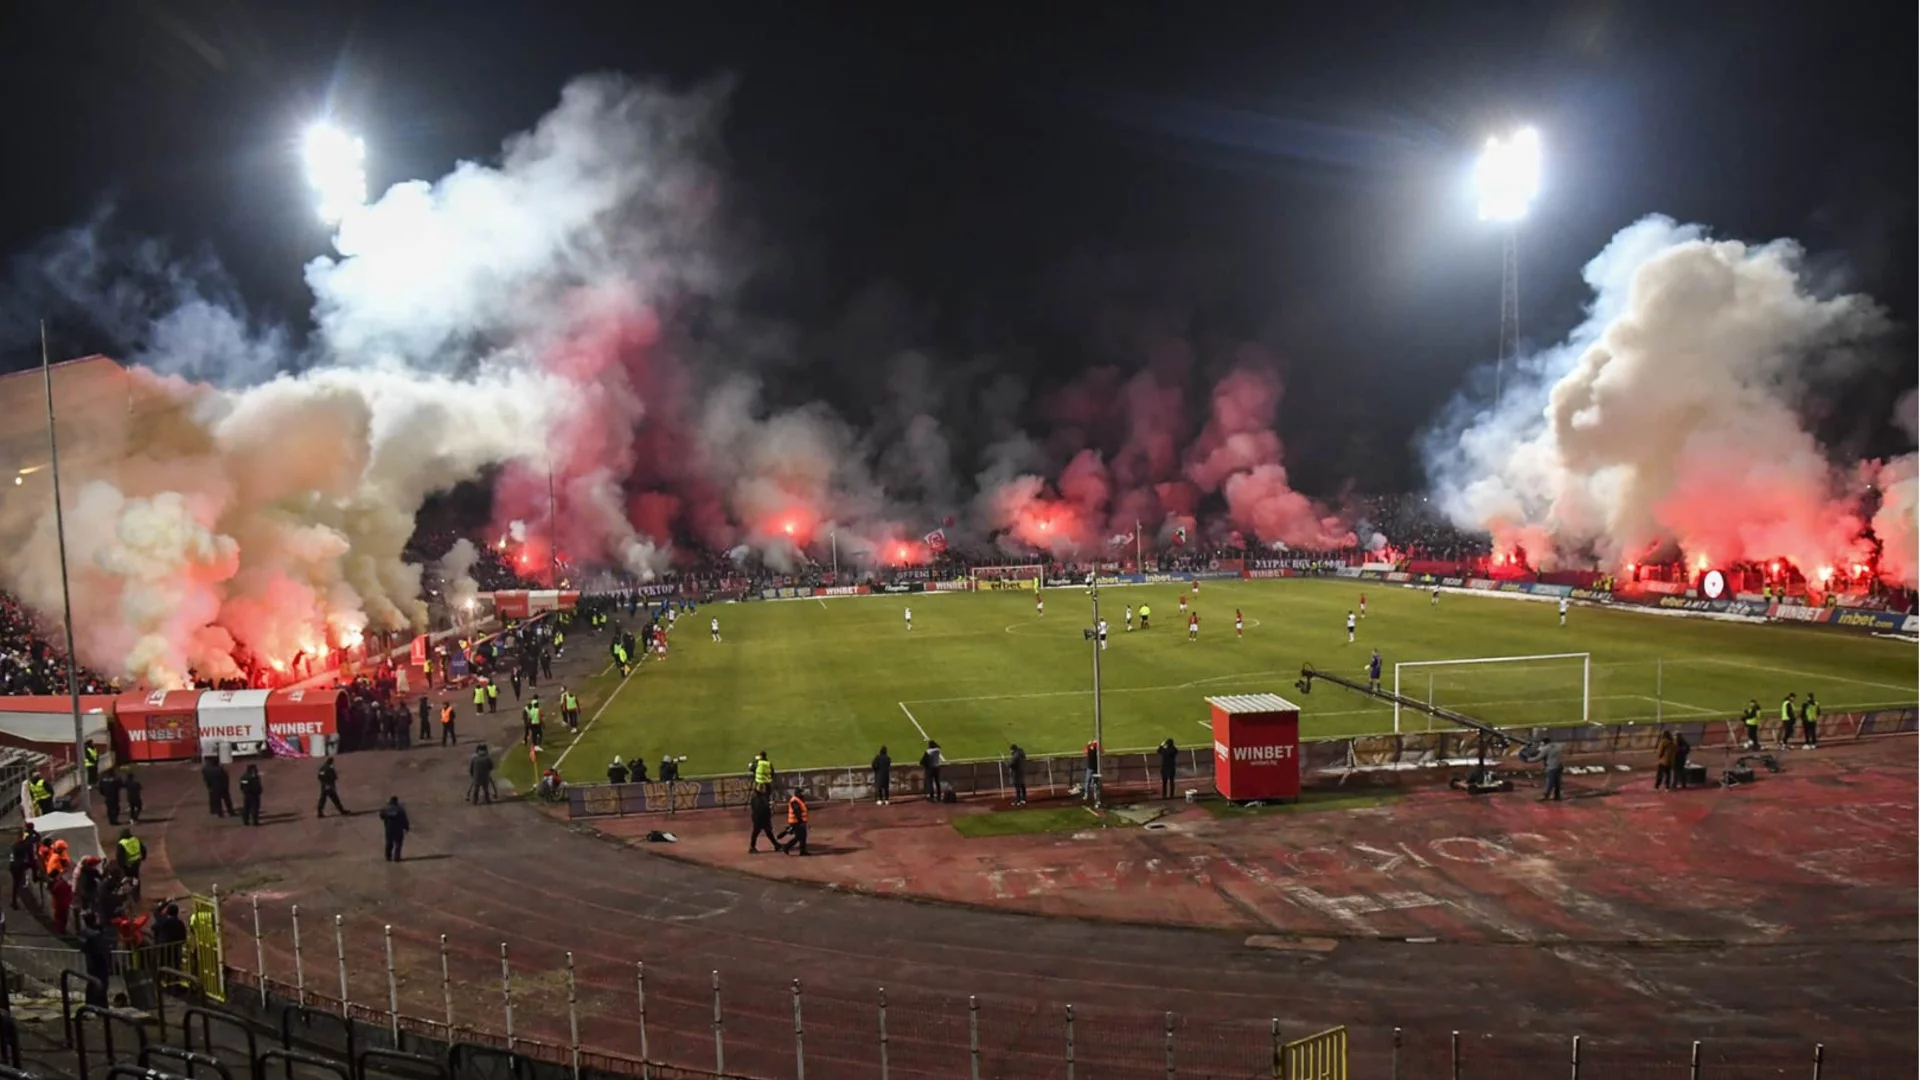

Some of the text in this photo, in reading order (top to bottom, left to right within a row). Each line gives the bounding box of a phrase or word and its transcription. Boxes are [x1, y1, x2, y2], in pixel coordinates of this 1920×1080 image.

[1249, 569, 1284, 578] WINBET
[826, 586, 858, 595] WINBET
[991, 580, 1021, 590] efbet
[1776, 605, 1824, 621] WINBET
[200, 725, 252, 737] WINBET
[269, 722, 324, 735] WINBET
[128, 729, 183, 742] WINBET
[1233, 745, 1293, 760] WINBET
